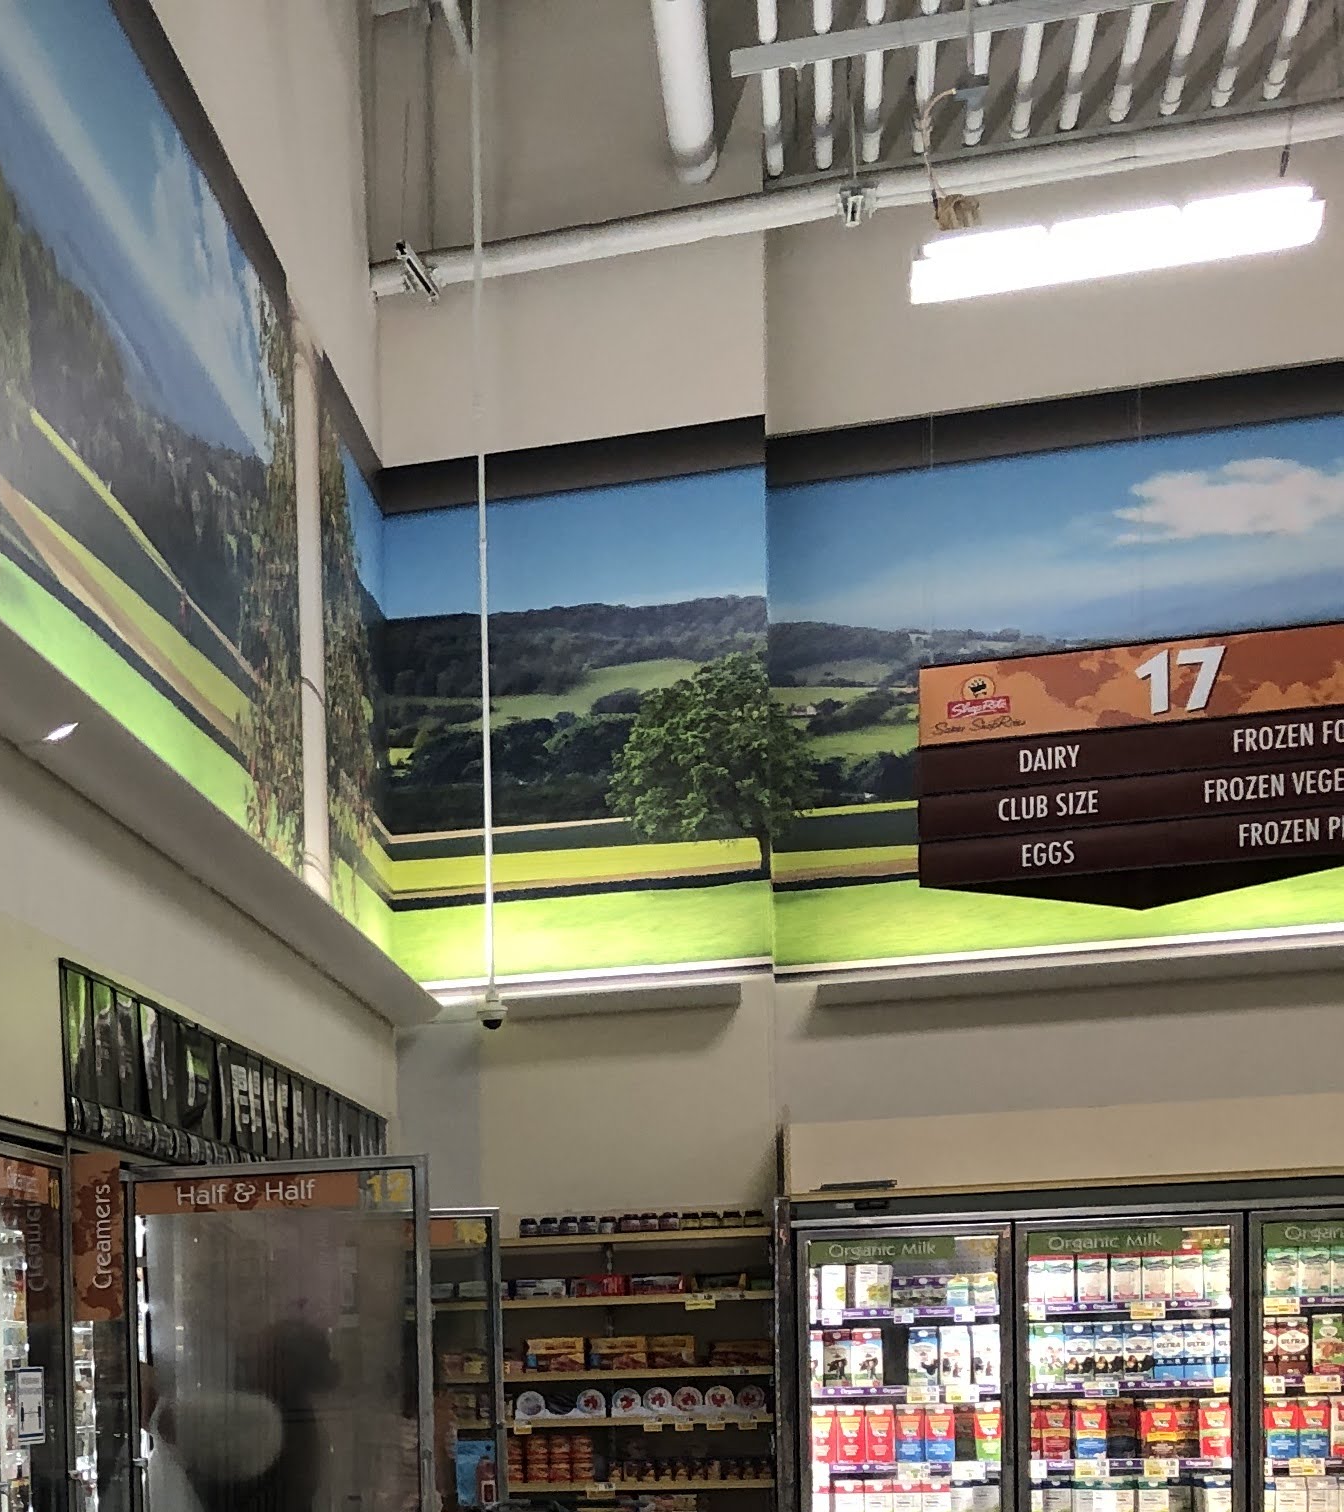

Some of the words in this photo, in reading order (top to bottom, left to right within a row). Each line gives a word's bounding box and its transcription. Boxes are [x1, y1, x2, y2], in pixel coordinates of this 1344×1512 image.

[1135, 645, 1226, 715] 17
[1233, 723, 1314, 754] FROZEN
[1018, 745, 1080, 773] DAIRY
[1204, 774, 1285, 804] FROZEN
[998, 797, 1048, 822] CLUB
[1056, 790, 1099, 817] SIZE
[1239, 818, 1319, 847] FROZEN
[1022, 841, 1075, 867] EGGS
[177, 1184, 228, 1206] Half
[234, 1182, 257, 1203] &
[265, 1179, 315, 1201] Half
[367, 1172, 409, 1203] 12
[91, 1184, 112, 1289] Creamers
[829, 1242, 895, 1260] Organic
[902, 1242, 936, 1255] Milk
[1049, 1236, 1120, 1252] Organic
[1126, 1233, 1162, 1246] Milk
[1280, 1338, 1308, 1346] ULTRA
